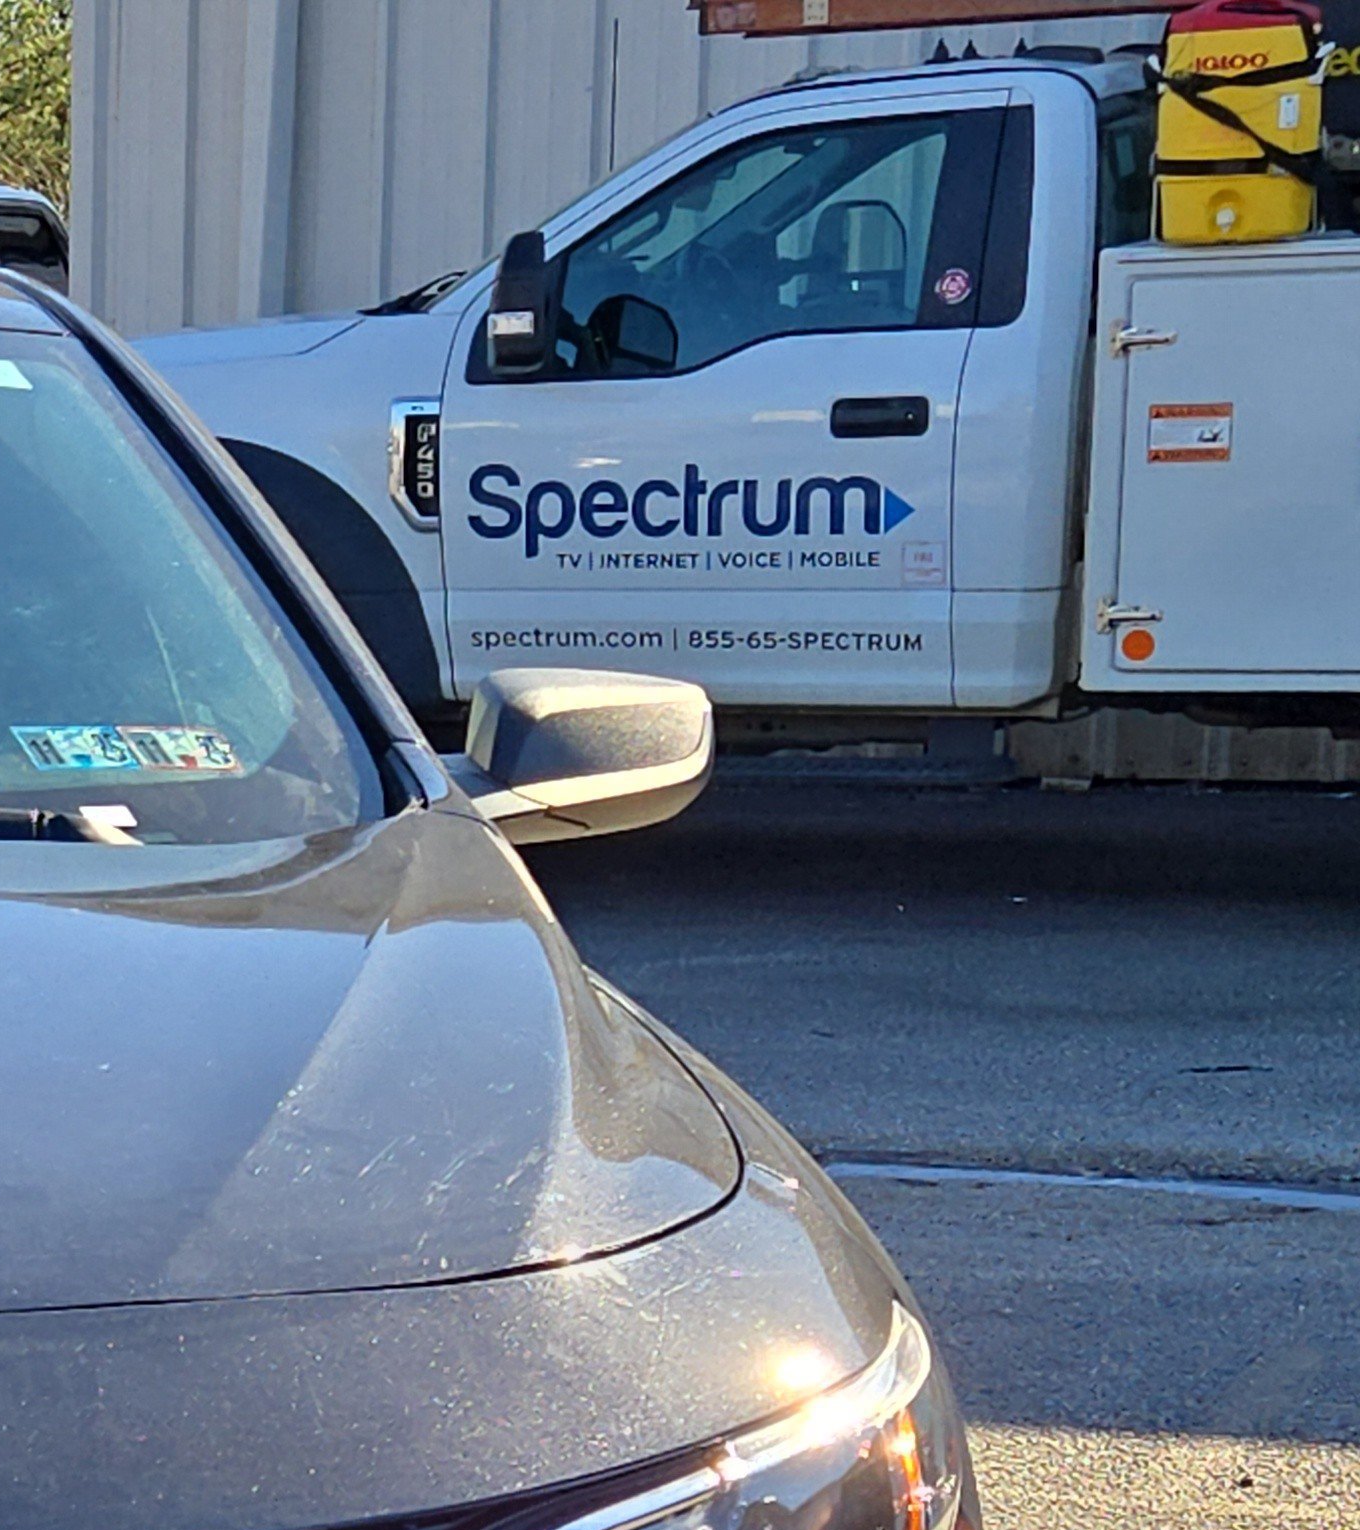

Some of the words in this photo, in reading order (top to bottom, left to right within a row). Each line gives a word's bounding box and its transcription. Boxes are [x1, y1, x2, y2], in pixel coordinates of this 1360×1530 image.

[467, 463, 881, 558] Spectrum
[556, 553, 582, 568] TV
[599, 552, 699, 568] INTERNET
[718, 551, 781, 568] VOICE
[800, 551, 881, 567] MOBILE
[471, 628, 664, 650] spectrum.com
[688, 630, 924, 651] 855-65-SPECTRUM
